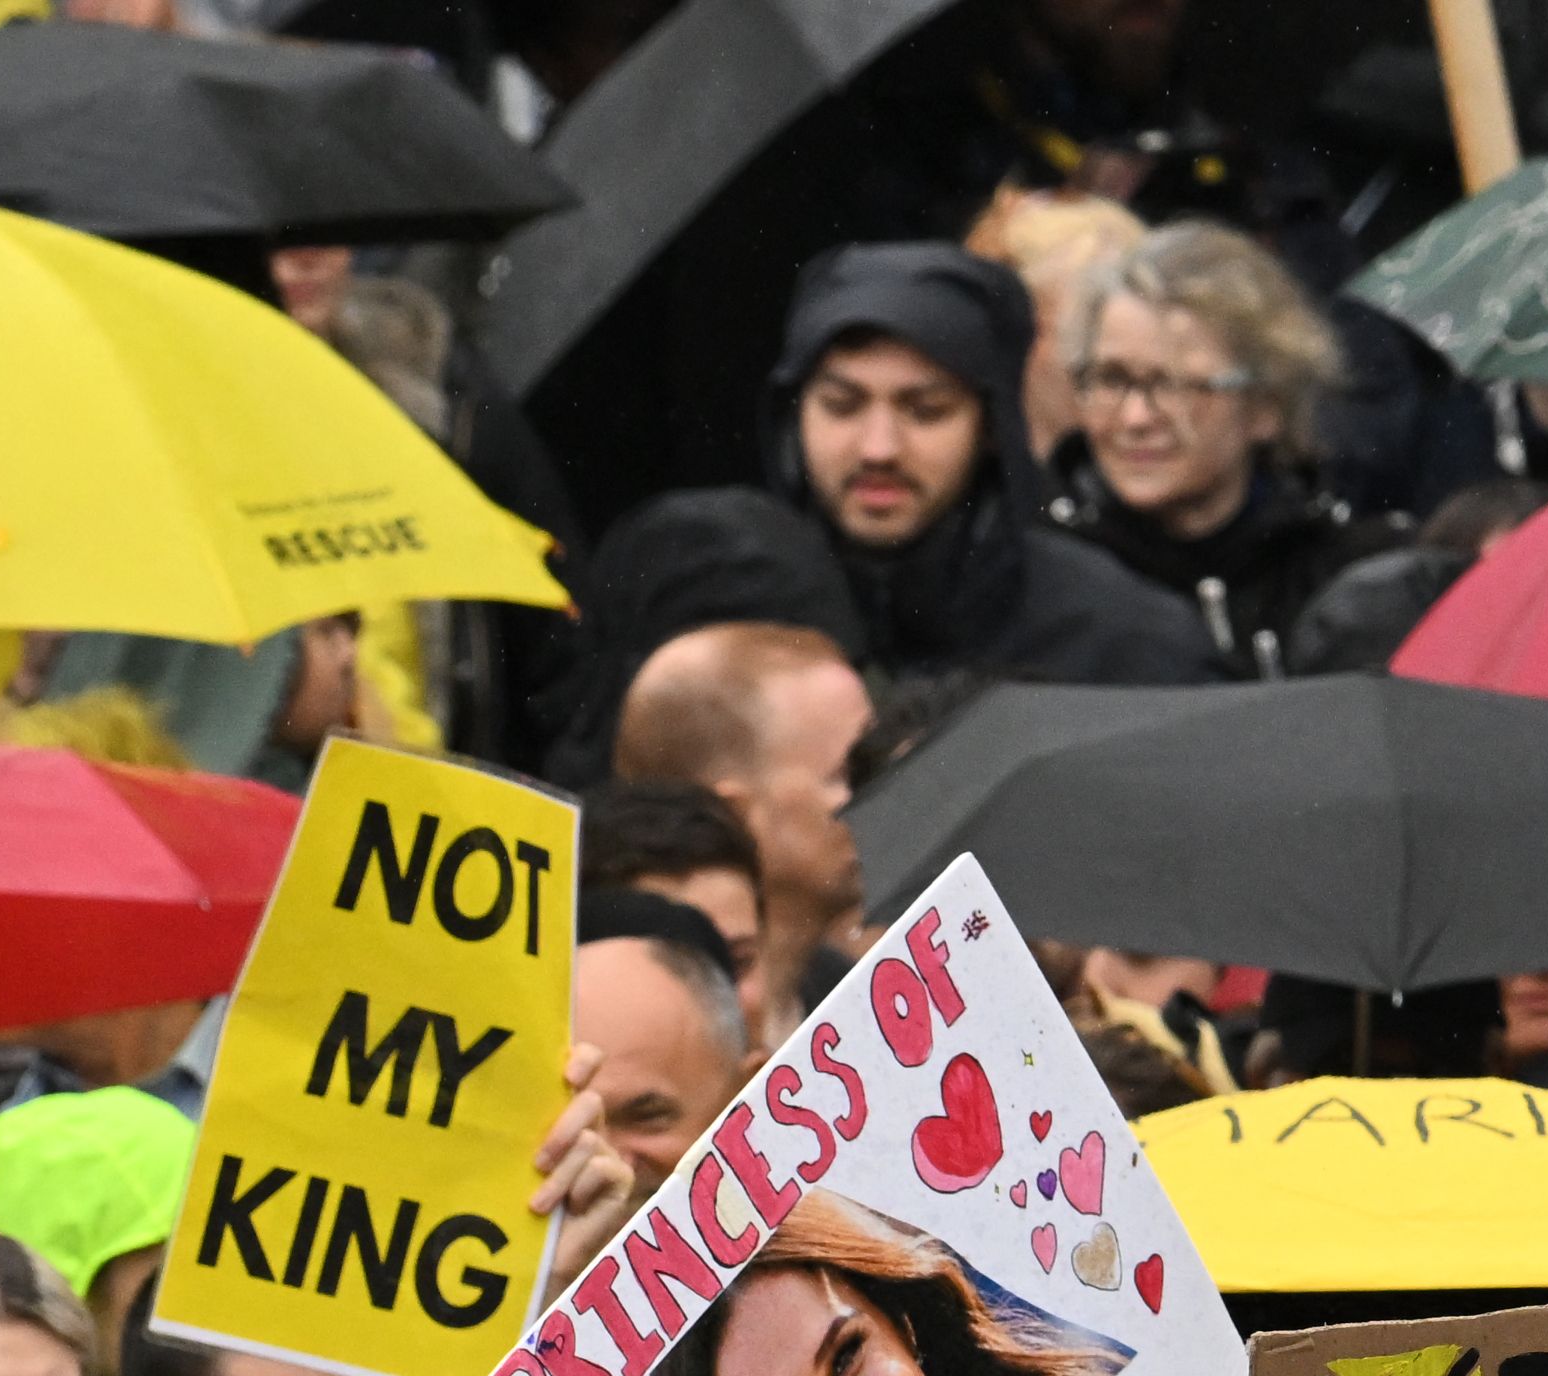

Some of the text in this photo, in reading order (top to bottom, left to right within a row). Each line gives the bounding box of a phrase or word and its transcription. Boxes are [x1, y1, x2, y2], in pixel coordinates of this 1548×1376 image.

[262, 515, 427, 569] RESCUE
[333, 799, 551, 957] NOT
[305, 989, 515, 1130] MY
[870, 905, 967, 1068] OF
[197, 1154, 511, 1330] KING
